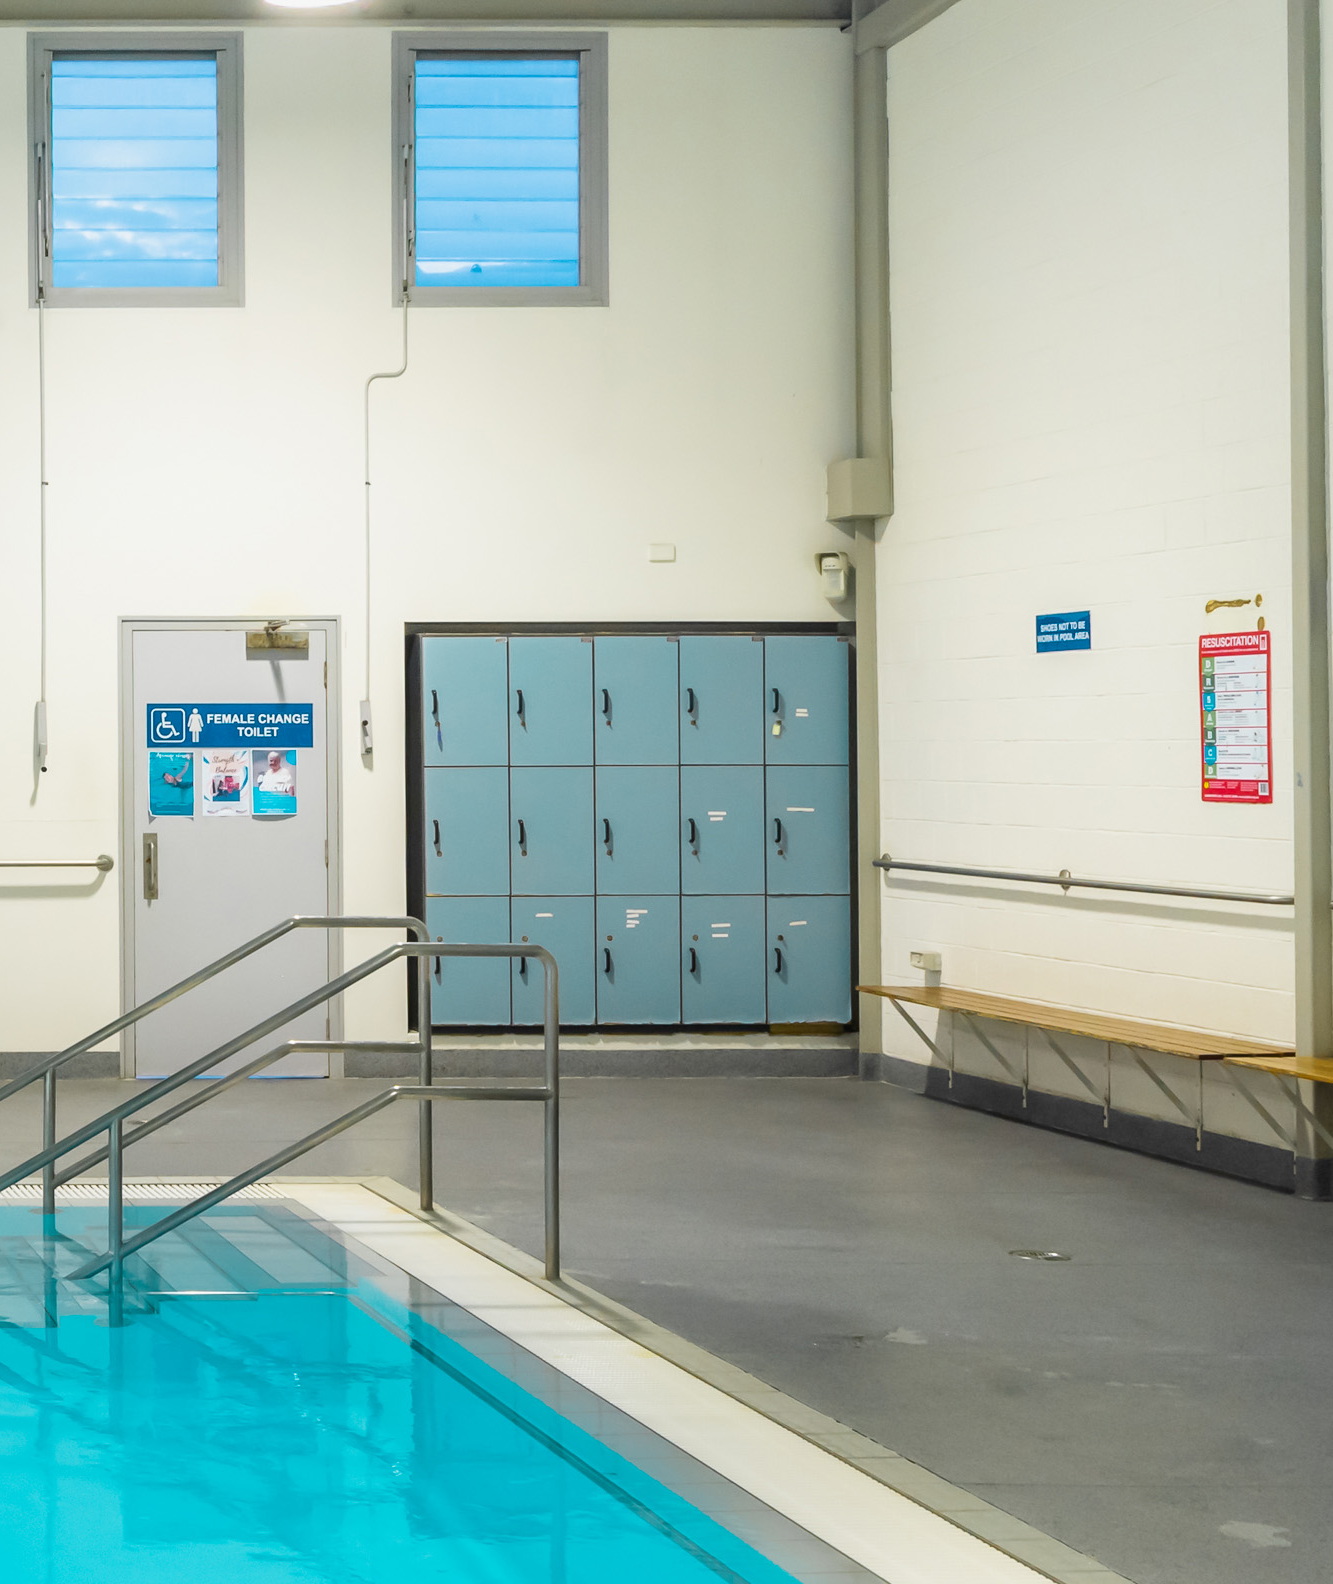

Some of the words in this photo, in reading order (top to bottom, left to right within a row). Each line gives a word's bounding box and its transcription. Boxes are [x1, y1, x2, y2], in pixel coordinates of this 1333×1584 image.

[1059, 622, 1069, 630] NOT
[1078, 621, 1085, 629] BE
[1059, 633, 1074, 641] POOL
[1201, 635, 1259, 648] RESUSCITATION
[206, 714, 255, 724] FEMALE
[258, 714, 309, 724] CHANGE
[1207, 713, 1213, 721] A
[237, 727, 279, 736] TOILET
